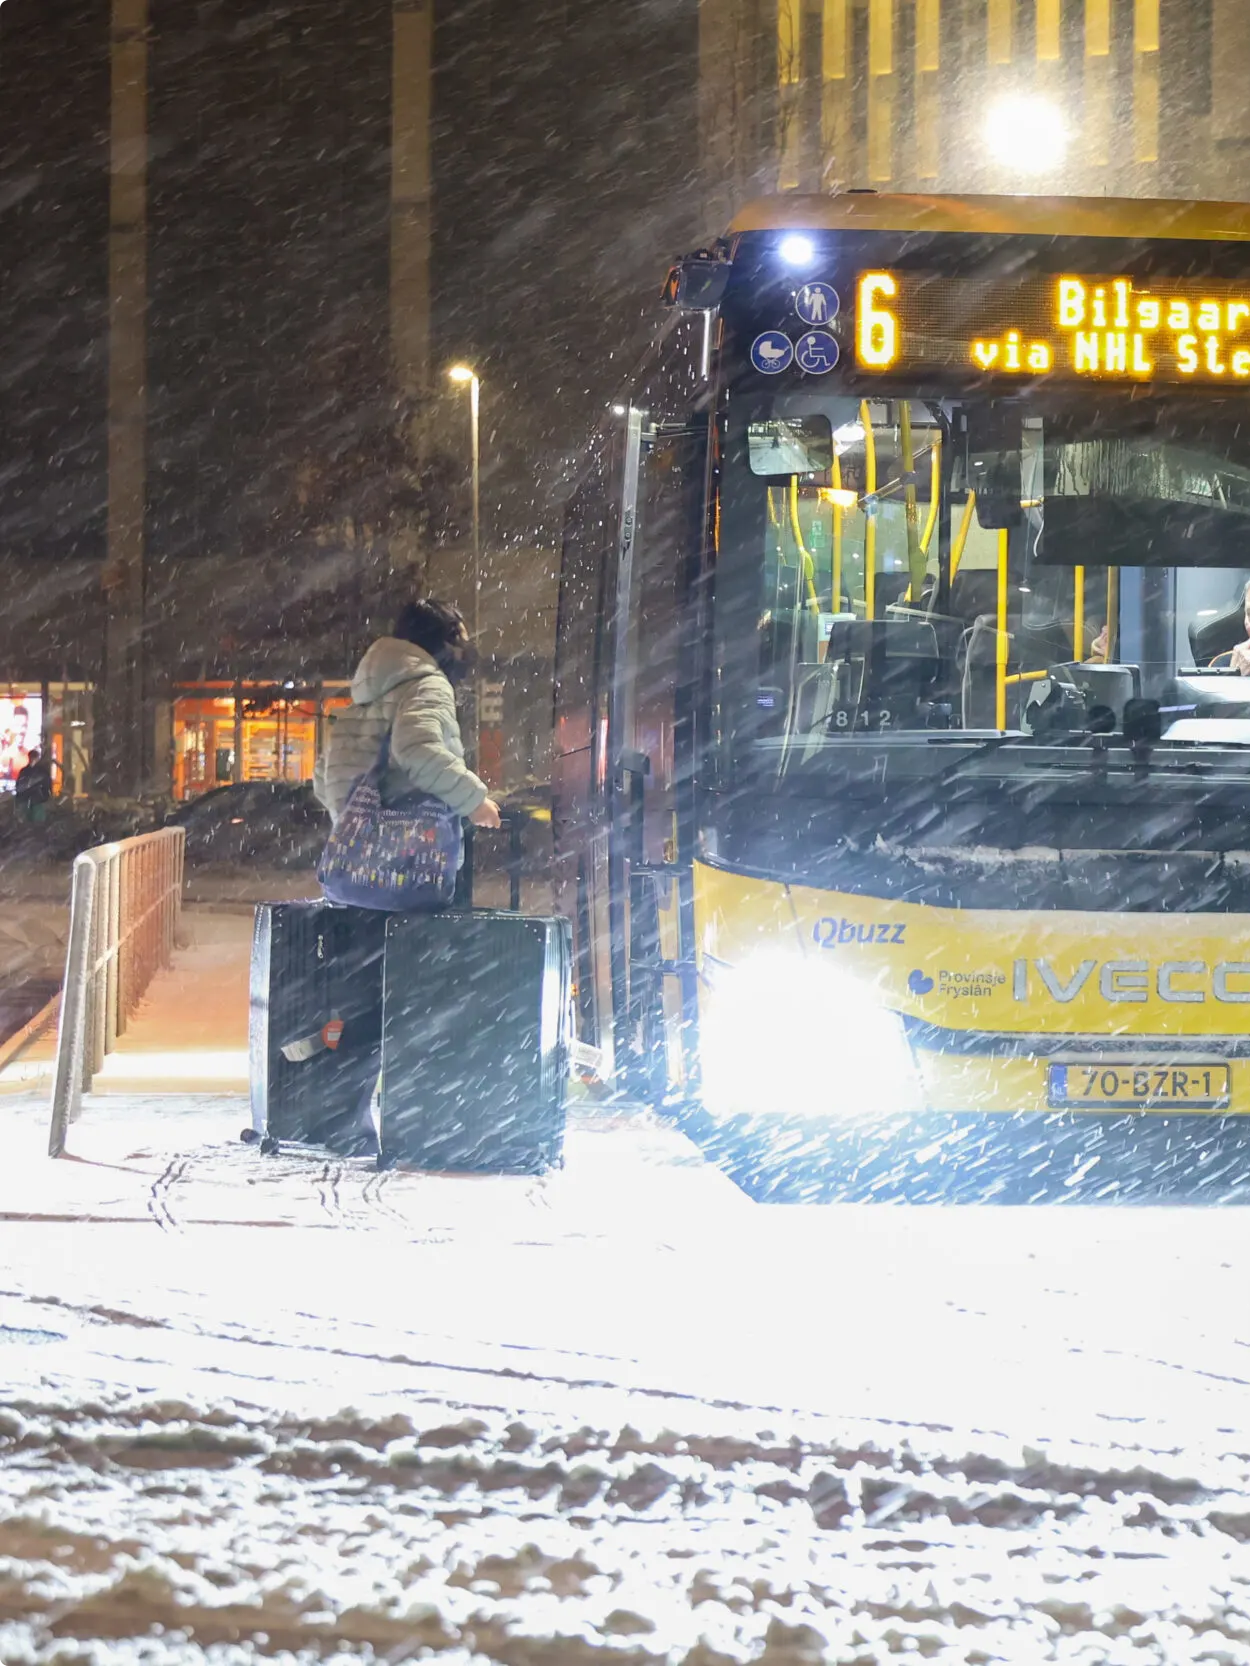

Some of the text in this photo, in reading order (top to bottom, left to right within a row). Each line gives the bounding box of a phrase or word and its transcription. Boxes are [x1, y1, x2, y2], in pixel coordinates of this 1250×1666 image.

[858, 271, 896, 366] 6
[974, 331, 1050, 370] via
[1074, 331, 1151, 372] NHL
[812, 916, 907, 949] Qbuzz
[938, 970, 1007, 988] Provinsje
[938, 984, 992, 999] Fryslân
[1081, 1069, 1212, 1097] 70-BZR-1
